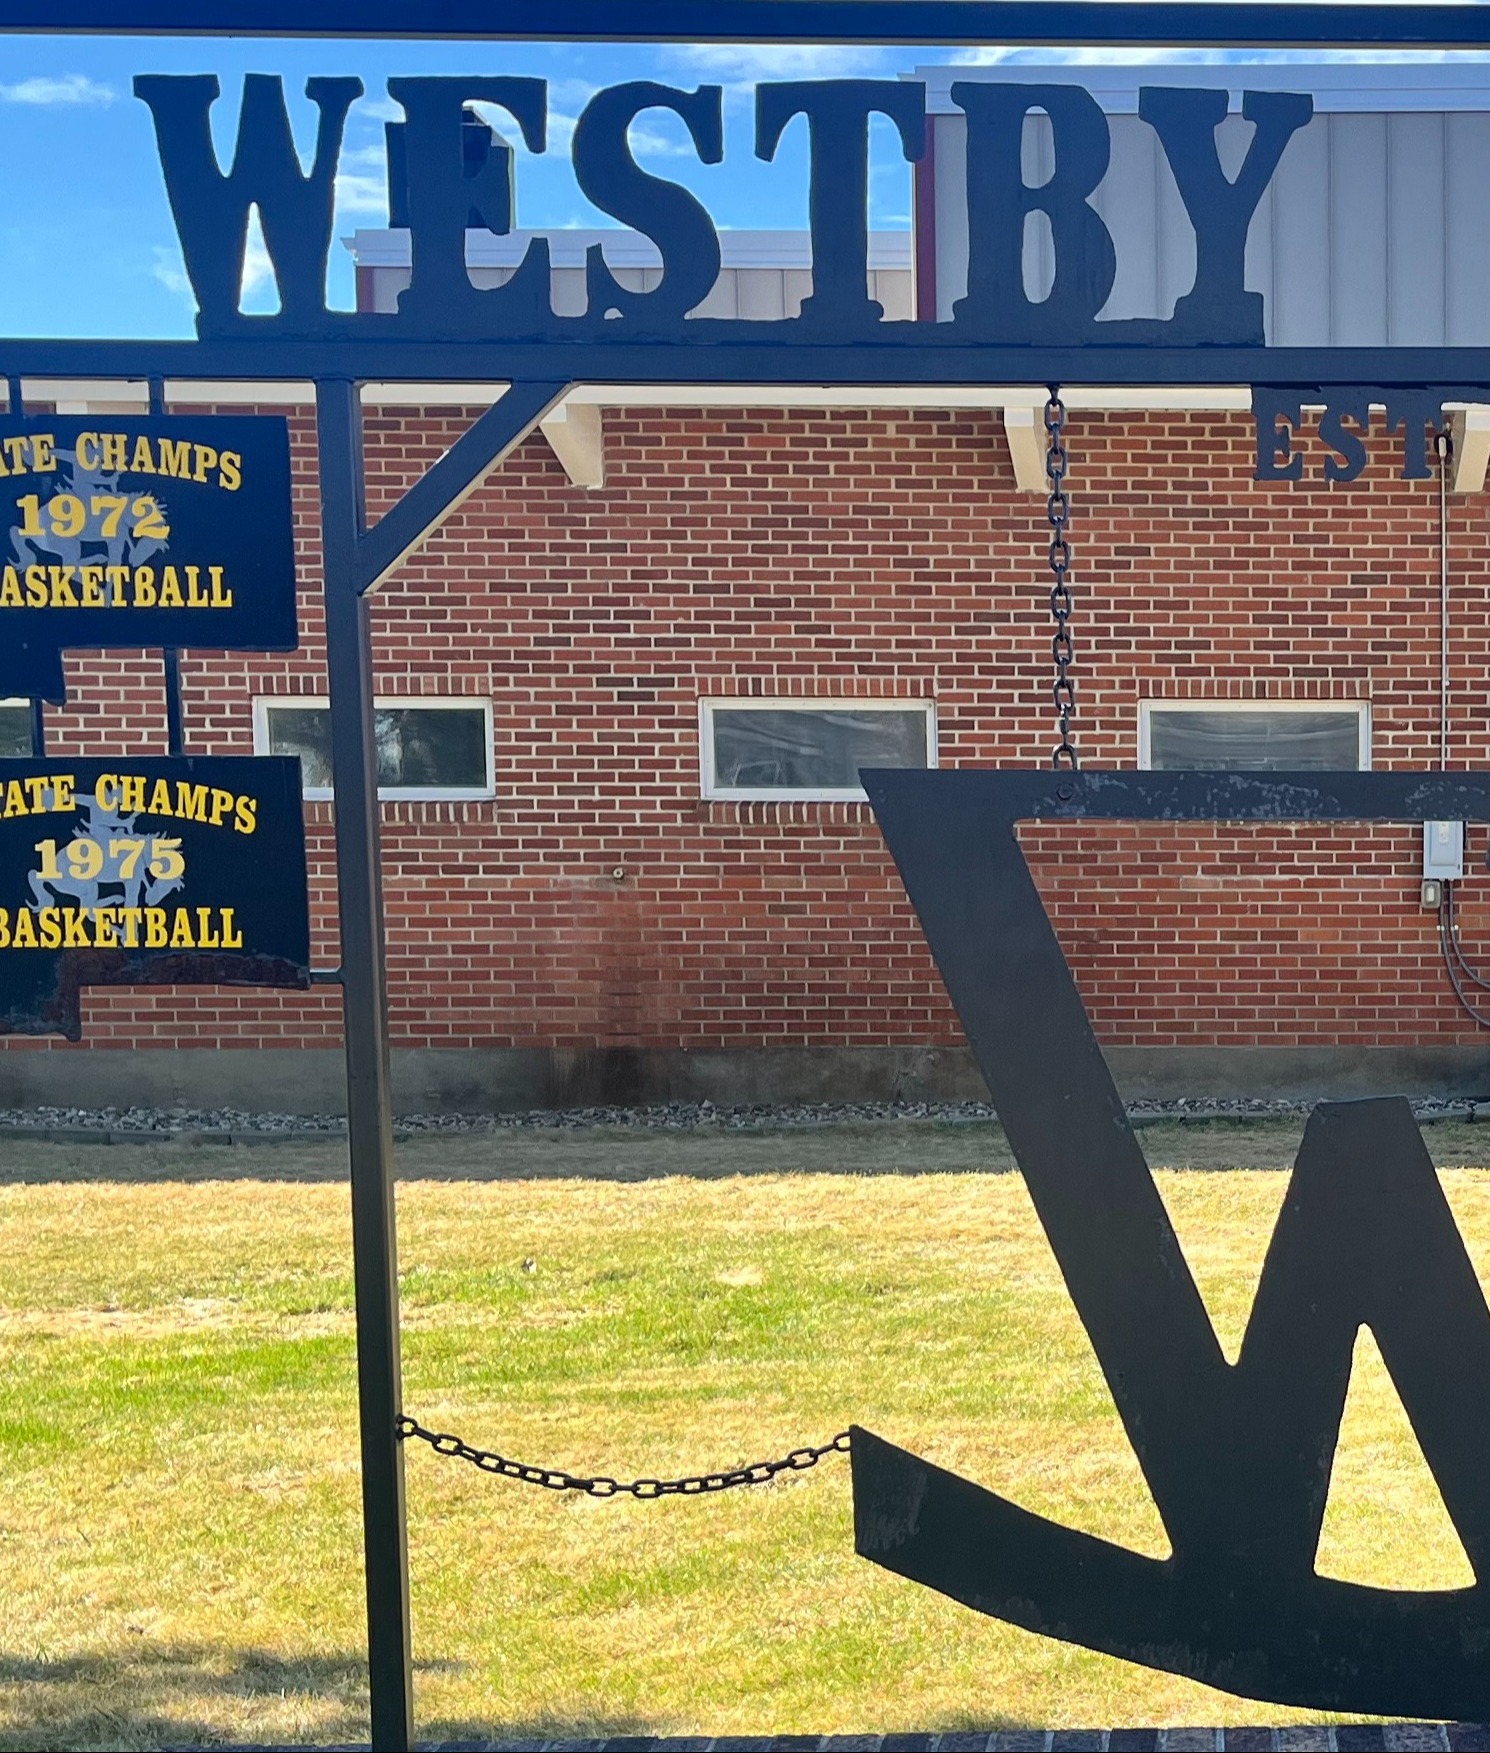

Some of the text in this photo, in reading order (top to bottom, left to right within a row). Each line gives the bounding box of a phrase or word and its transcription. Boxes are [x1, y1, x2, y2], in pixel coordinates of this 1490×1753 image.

[133, 74, 1313, 334] WESTBY
[75, 432, 242, 491] CHAMPS
[1254, 396, 1446, 481] EST
[17, 494, 170, 538] 1972
[0, 773, 257, 834] ATE CHAMPS
[35, 838, 186, 880] 1975
